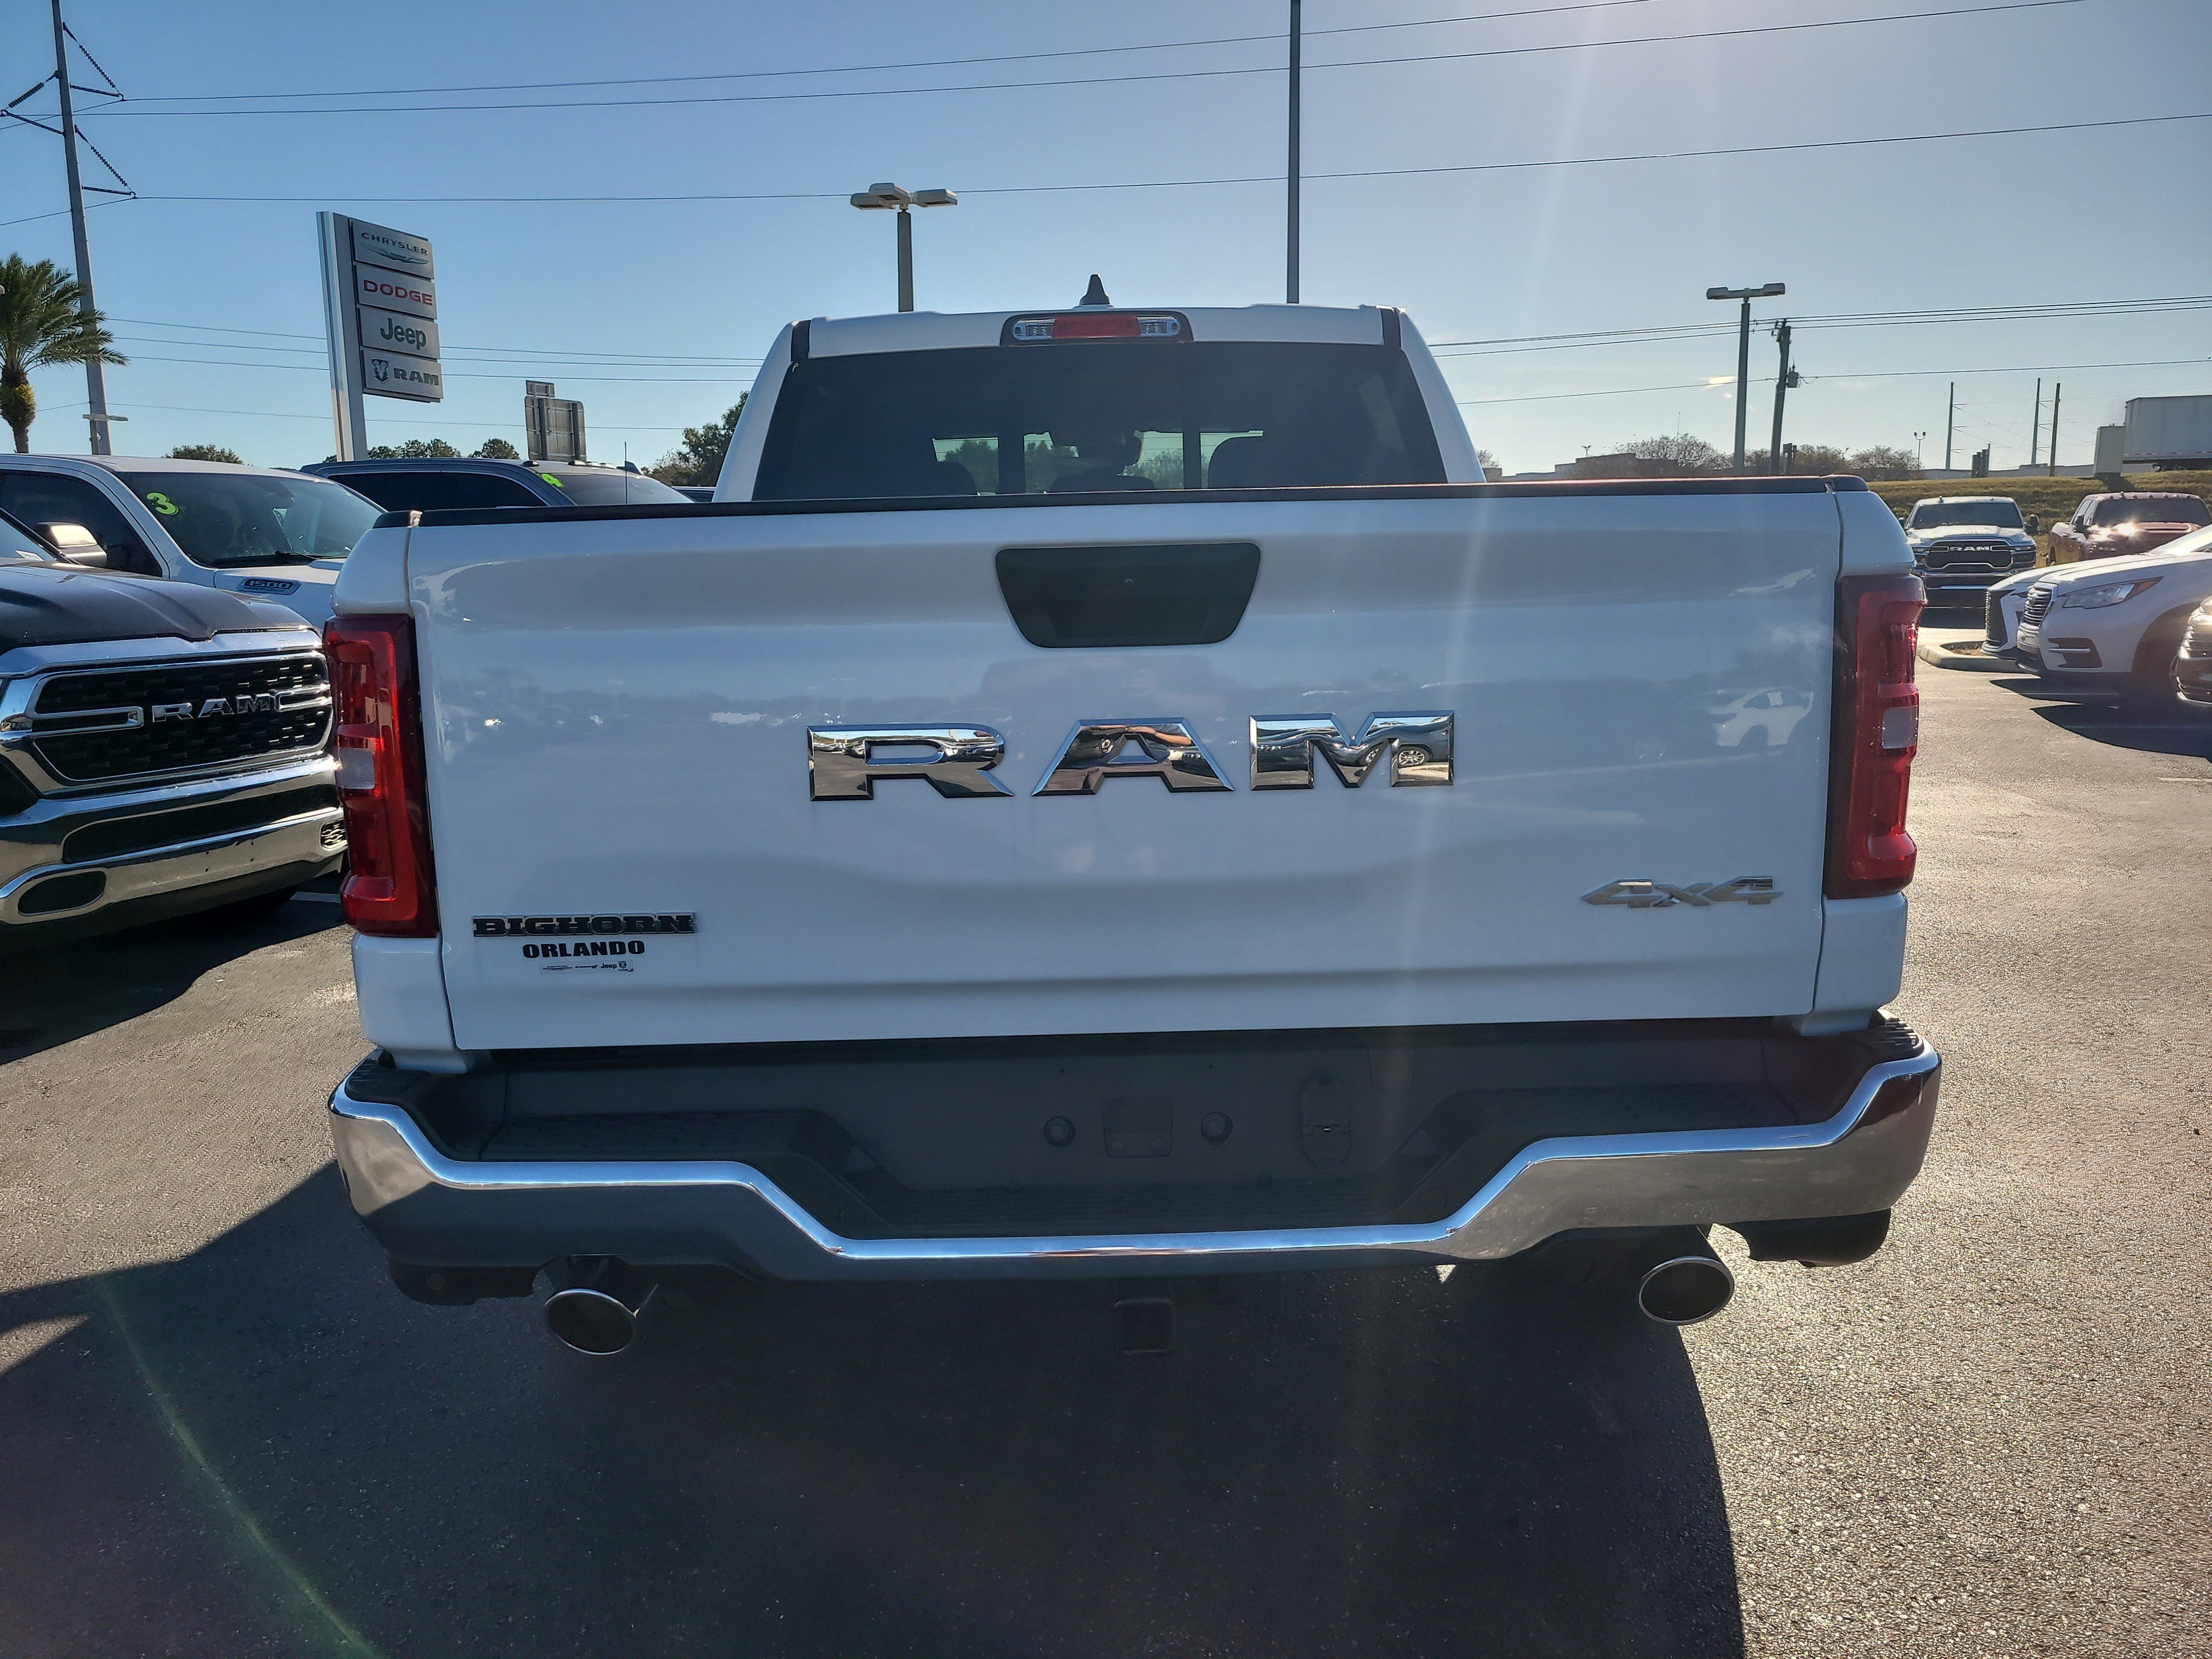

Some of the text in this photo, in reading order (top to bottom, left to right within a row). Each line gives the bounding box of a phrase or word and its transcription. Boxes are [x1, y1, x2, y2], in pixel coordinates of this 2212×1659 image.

[362, 232, 428, 256] CHRYSLER
[363, 279, 433, 306] DODGE
[380, 317, 426, 351] Jeep
[393, 368, 439, 386] RAM
[146, 492, 179, 516] 3
[249, 580, 291, 589] 1500
[151, 692, 272, 724] RAM
[806, 710, 1455, 801] RAM
[1579, 875, 1784, 909] 4x4
[472, 912, 696, 937] BIGHORN
[522, 939, 645, 959] ORLANDO
